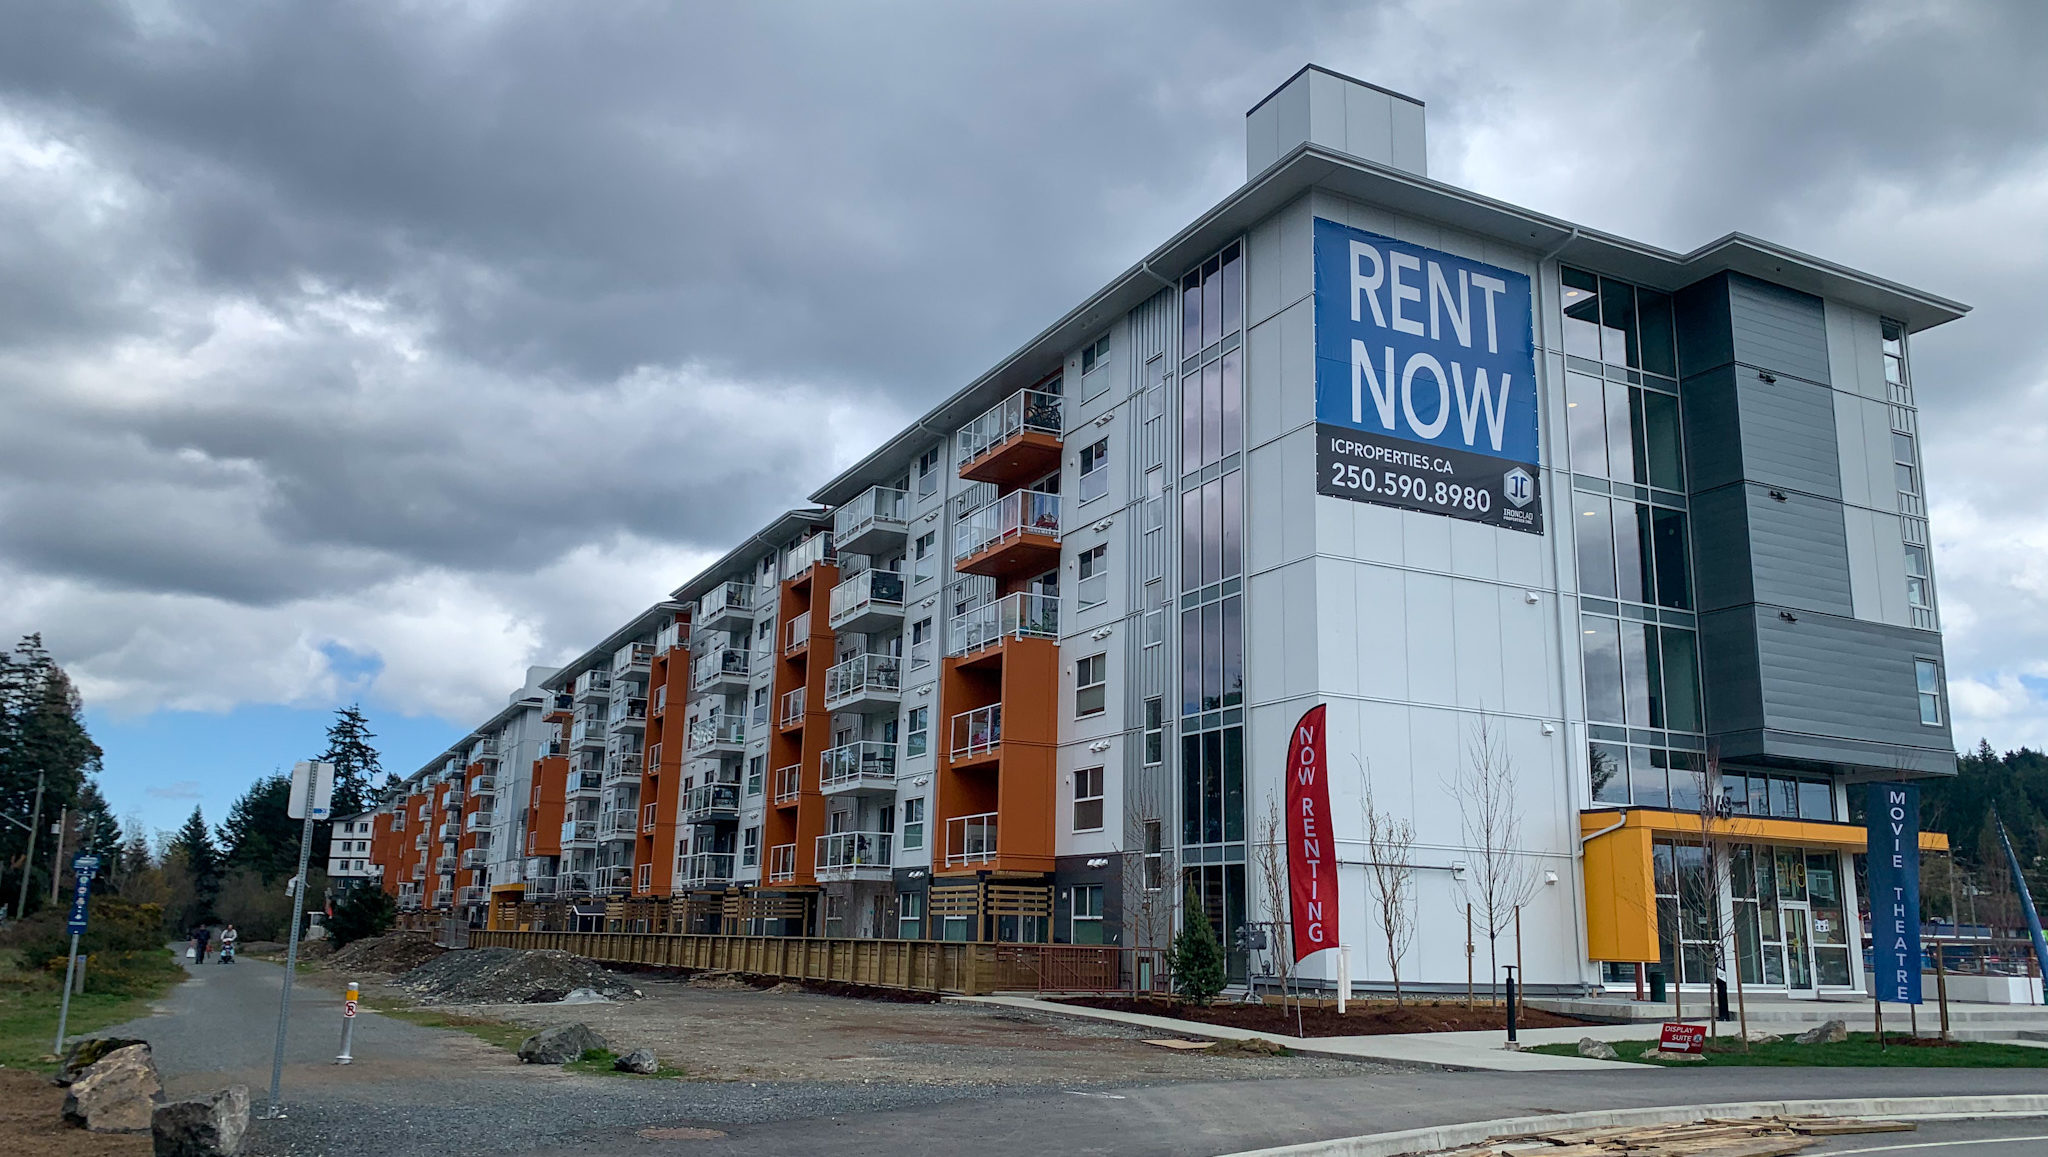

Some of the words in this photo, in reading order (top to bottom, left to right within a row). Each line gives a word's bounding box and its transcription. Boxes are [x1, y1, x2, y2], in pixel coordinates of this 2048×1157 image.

[1350, 239, 1506, 354] RENT
[1351, 338, 1511, 452] NOW
[1331, 438, 1454, 474] ICPROPERTIES.CA
[1332, 462, 1491, 513] 250.590.8980
[1503, 508, 1534, 521] IRONCLAD
[1298, 725, 1316, 786] NOW
[1890, 791, 1906, 868] MOVIE
[1302, 797, 1324, 943] RENTING
[1893, 887, 1909, 1000] THEATRE
[1665, 1026, 1694, 1034] DISPLAY
